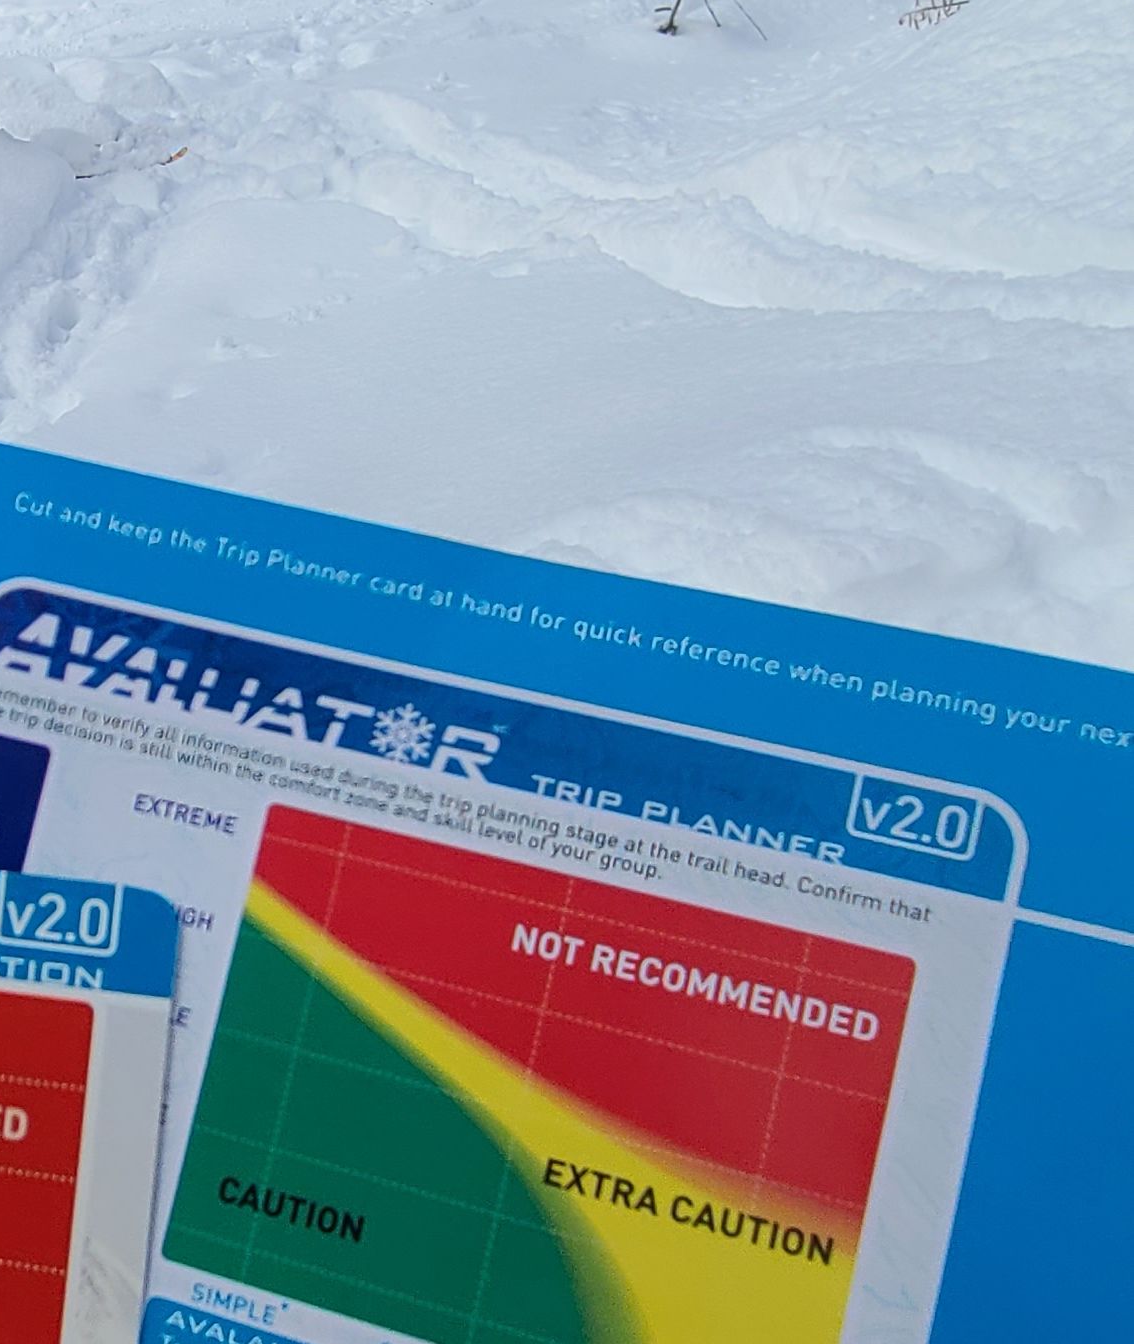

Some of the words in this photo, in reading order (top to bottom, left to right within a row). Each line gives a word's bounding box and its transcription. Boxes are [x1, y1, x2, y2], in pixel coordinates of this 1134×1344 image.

[15, 492, 53, 517] Cut
[60, 506, 101, 529] and
[108, 515, 162, 546] keep
[170, 529, 206, 553] the
[216, 537, 259, 567] Trip
[267, 549, 361, 586] Planner
[370, 574, 423, 601] card
[461, 593, 522, 623] hand
[530, 606, 565, 630] for
[574, 618, 643, 648] quick
[651, 634, 780, 676] reference
[789, 663, 863, 692] when
[871, 679, 996, 726] planning
[1005, 707, 1070, 730] your
[1080, 723, 1134, 747] nex
[8, 708, 38, 729] trip
[43, 716, 114, 750] decision
[118, 735, 134, 751] is
[139, 740, 170, 760] still
[177, 749, 230, 774] within
[234, 762, 264, 783] the
[268, 772, 340, 804] comfort
[392, 801, 428, 824] and
[434, 809, 472, 834] skill
[478, 819, 522, 846] level
[527, 833, 546, 850] of
[551, 841, 596, 862] your
[600, 854, 662, 881] group.
[81, 707, 98, 723] to
[103, 713, 149, 738] verify
[155, 725, 177, 742] all
[181, 732, 285, 768] information
[290, 759, 335, 781] used
[338, 768, 399, 799] during
[404, 783, 434, 804] the
[439, 793, 471, 817] trip
[477, 802, 560, 838] planning
[566, 824, 618, 850] stage
[624, 836, 643, 854] at
[650, 838, 681, 863] the
[687, 850, 730, 875] trail
[798, 876, 882, 912] Confirm
[889, 898, 933, 923] that
[133, 793, 240, 836] EXTREME
[531, 774, 622, 809] TRIP
[641, 800, 846, 864] PLANNER
[862, 795, 969, 849] v2.0
[6, 892, 110, 946] v2.0
[176, 903, 214, 931] IGH
[511, 923, 584, 965] NOT
[590, 944, 880, 1042] RECOMMENDED
[218, 1176, 366, 1244] CAUTION
[542, 1158, 658, 1216] EXTRA
[670, 1195, 835, 1265] CAUTION
